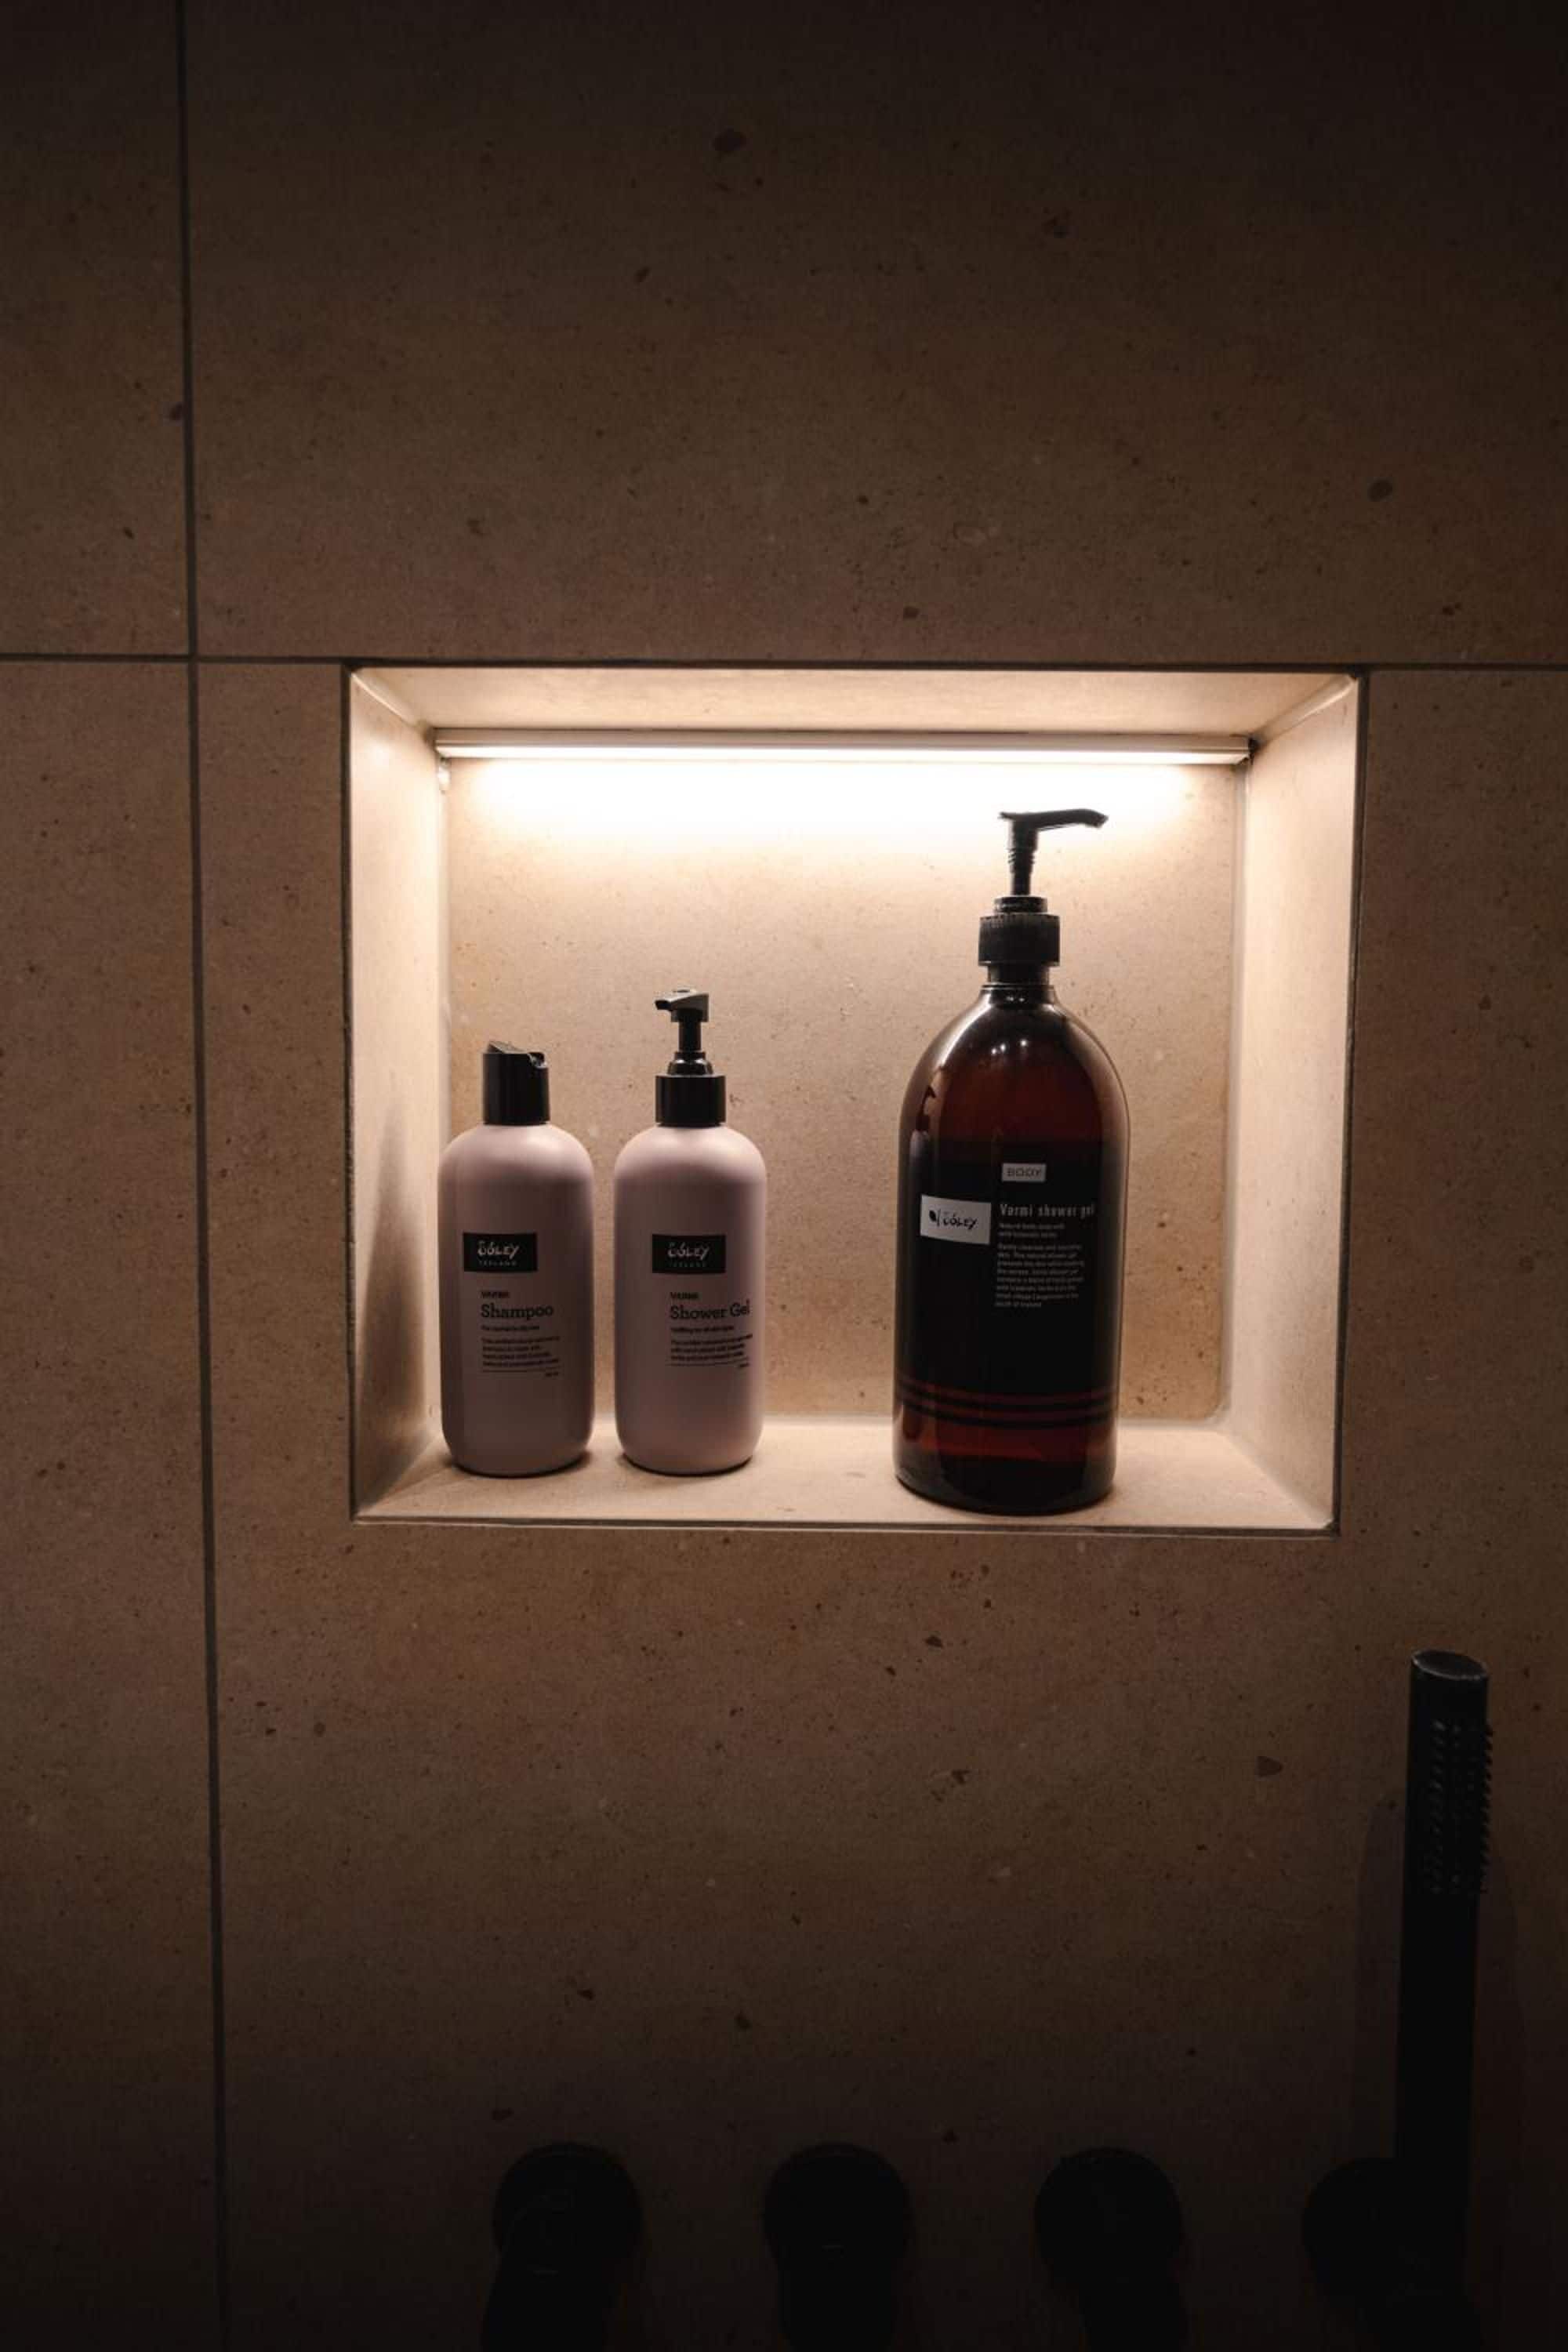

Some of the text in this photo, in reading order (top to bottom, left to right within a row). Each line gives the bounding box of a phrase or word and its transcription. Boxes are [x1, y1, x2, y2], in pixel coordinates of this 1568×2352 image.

[481, 1302, 554, 1321] Shampoo
[670, 1298, 750, 1319] Shower Gel
